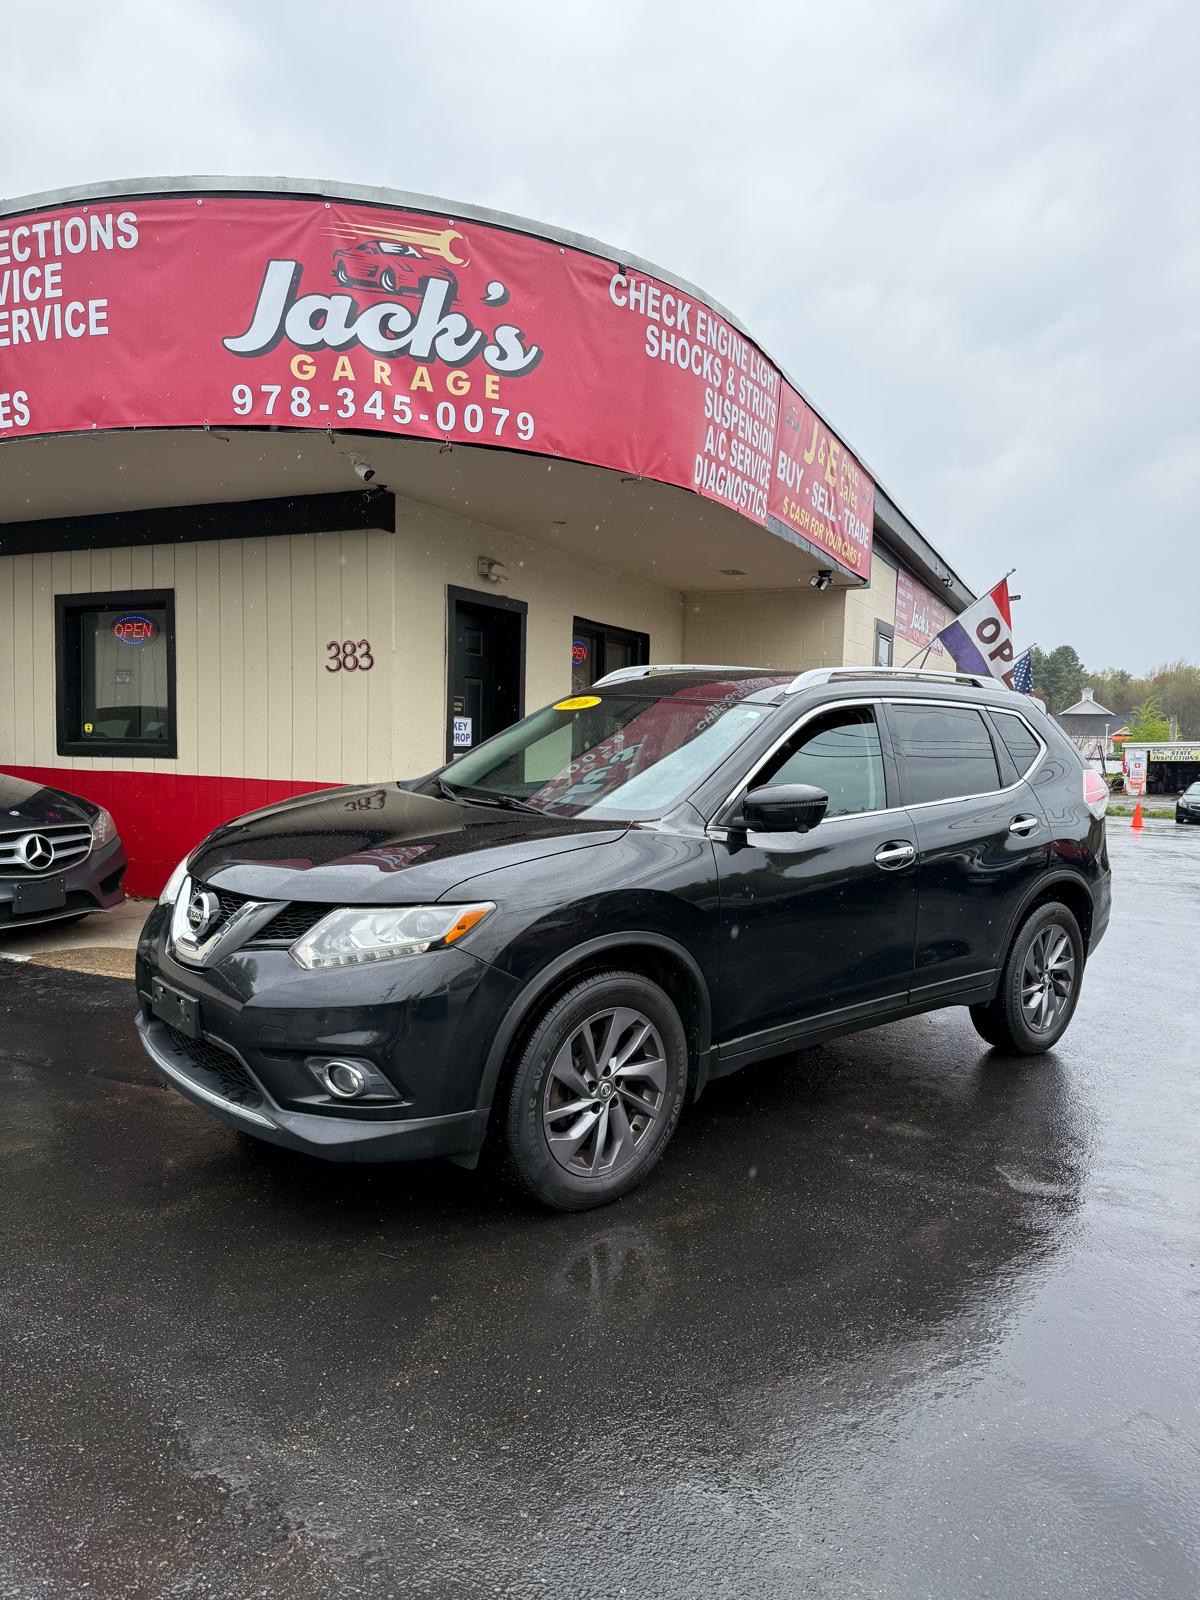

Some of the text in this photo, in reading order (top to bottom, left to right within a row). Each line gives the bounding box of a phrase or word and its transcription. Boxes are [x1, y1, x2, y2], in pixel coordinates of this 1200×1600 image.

[0, 211, 139, 265] ECTIONS
[0, 298, 109, 347] ERVICE
[222, 258, 540, 371] Jack's
[609, 273, 779, 398] CHECK ENGINE LIGHT
[290, 354, 500, 400] GARAGE
[645, 324, 777, 429] SHOCKS & STRUTS
[0, 390, 31, 429] ES
[231, 384, 535, 441] 978-345-0079
[704, 387, 775, 460] SUSPENSION
[704, 425, 772, 490] A/C SERVICE
[803, 420, 819, 465] J
[817, 438, 826, 467] &
[824, 438, 840, 488] E
[694, 453, 768, 519] DIAGNOSTICS
[776, 450, 870, 550] BUY SELL TRADE
[789, 502, 811, 531] CASH
[810, 517, 825, 543] FOR
[824, 526, 843, 553] YOUR
[114, 623, 152, 638] OPEN
[325, 639, 374, 673] 383
[571, 646, 587, 661] PEN
[454, 733, 470, 743] ROP
